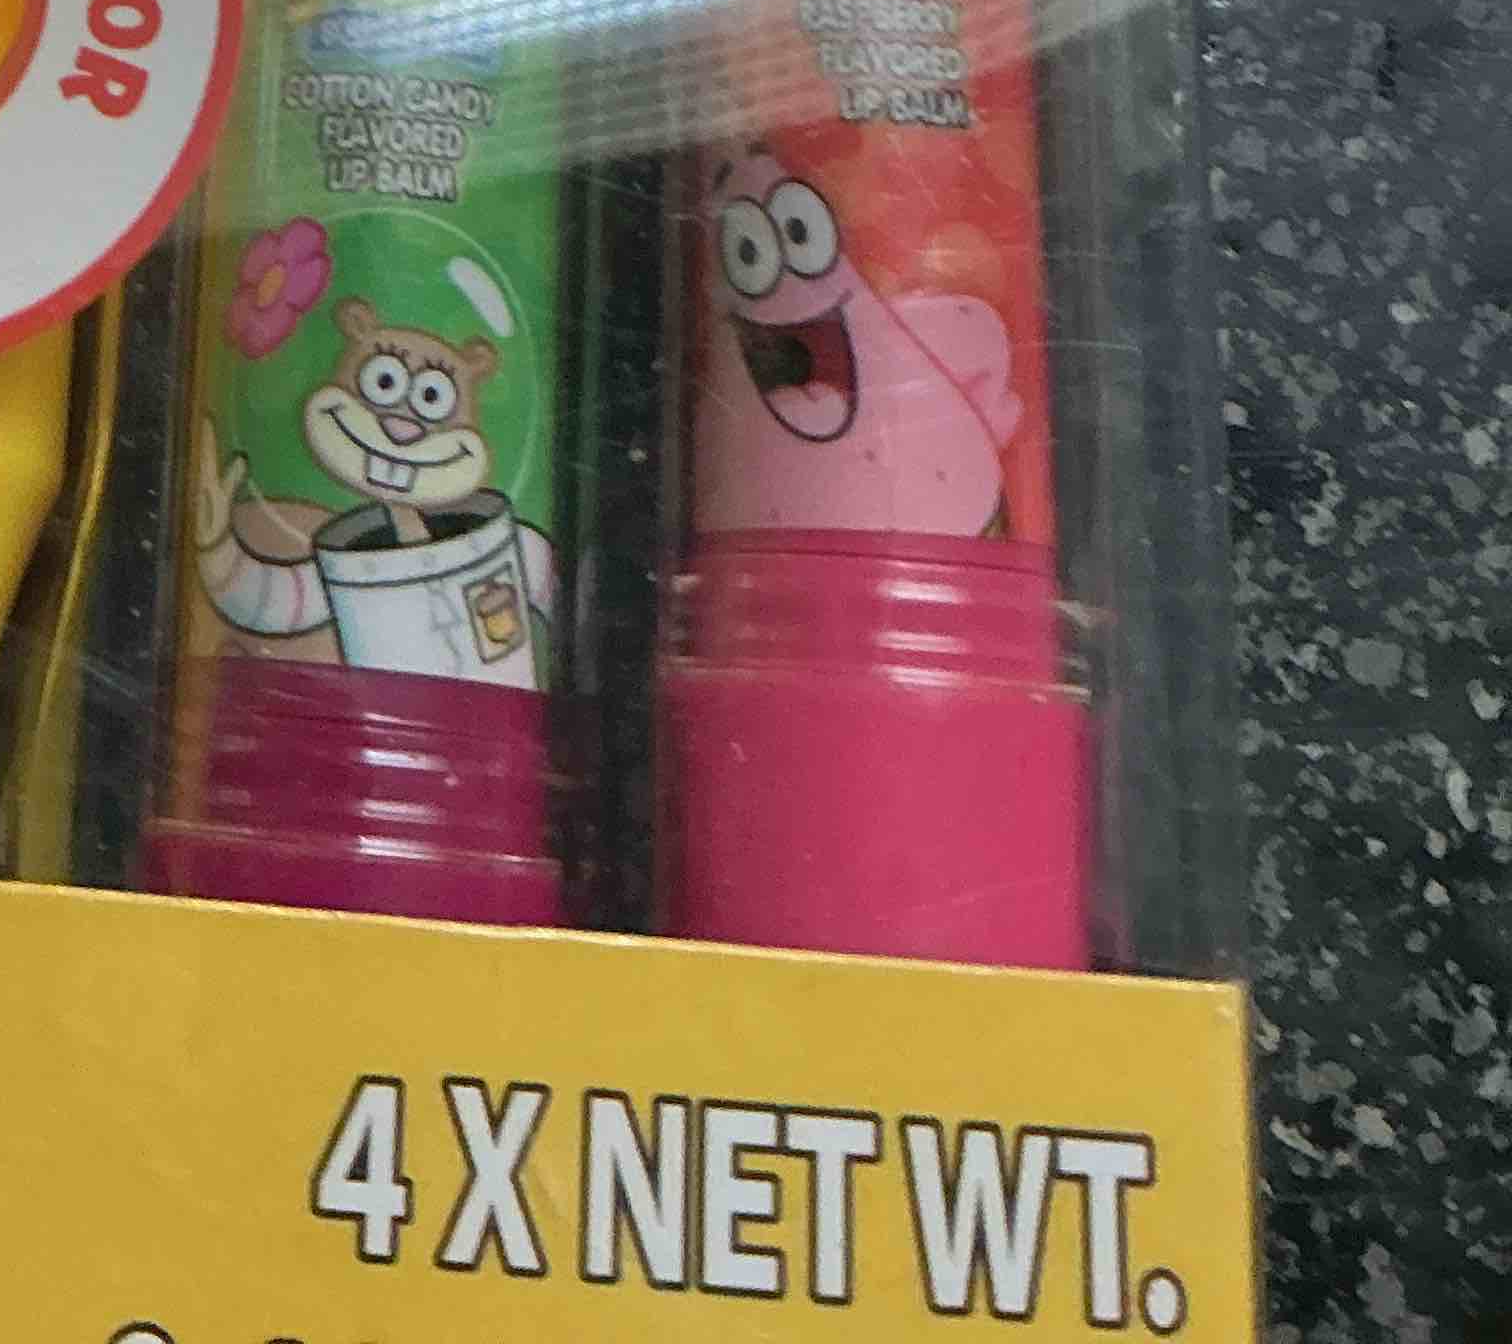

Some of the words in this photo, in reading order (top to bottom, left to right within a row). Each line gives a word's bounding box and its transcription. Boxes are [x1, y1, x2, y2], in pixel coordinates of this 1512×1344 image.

[282, 72, 393, 113] COTTON
[320, 114, 466, 160] FLAVORED
[326, 156, 370, 192] LIP
[373, 162, 458, 202] BALM
[311, 1076, 413, 1263] 4
[435, 1079, 549, 1278] X
[577, 1088, 884, 1304] NET
[901, 1117, 1189, 1336] WT.
